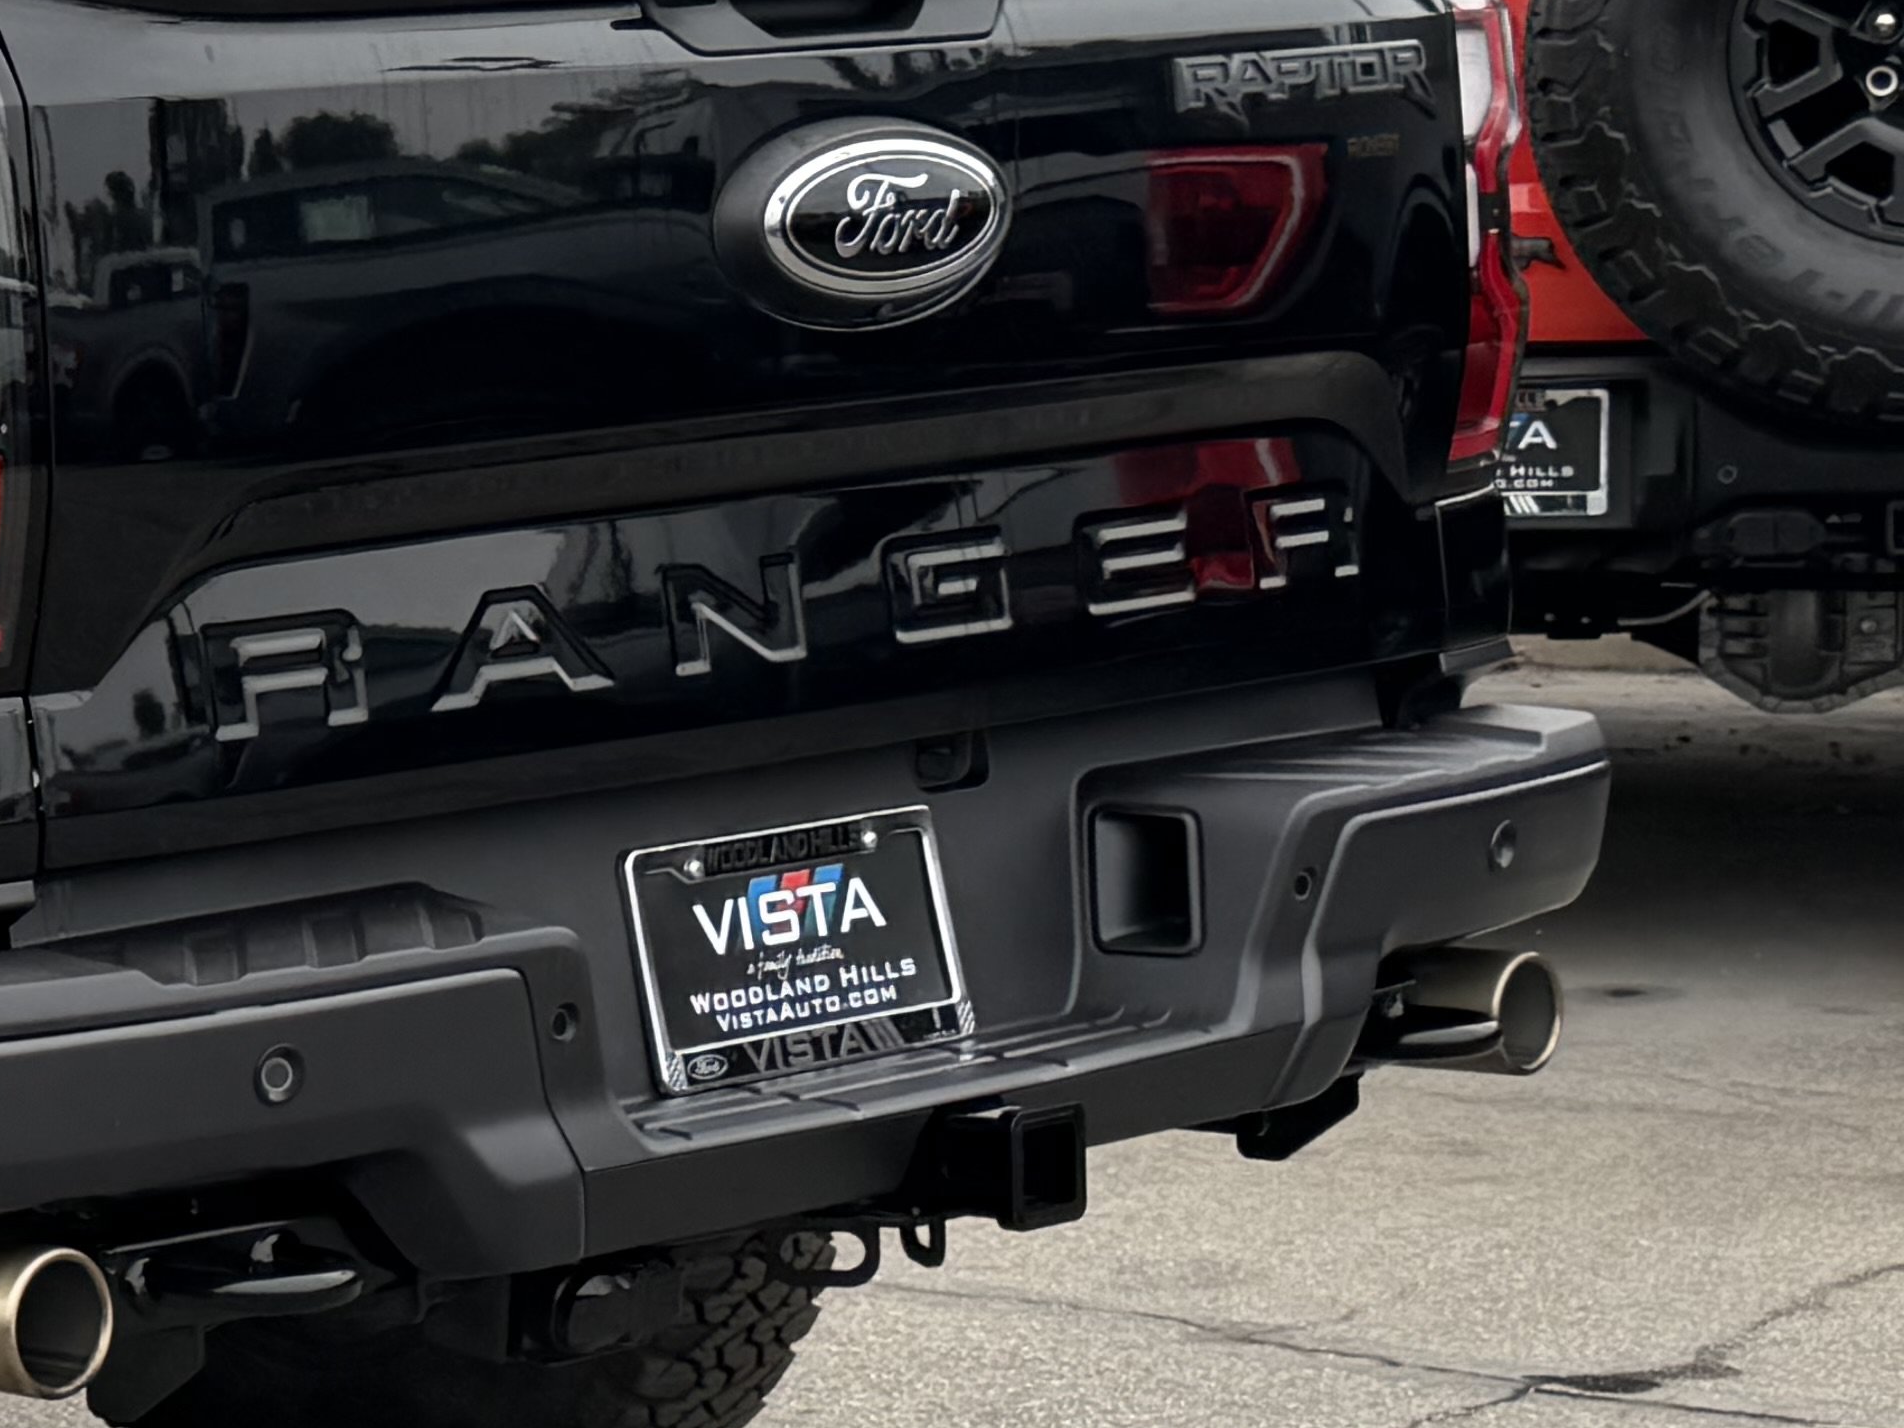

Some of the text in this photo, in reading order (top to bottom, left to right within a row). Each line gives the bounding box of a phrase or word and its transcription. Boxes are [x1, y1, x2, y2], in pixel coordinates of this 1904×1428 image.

[1172, 38, 1436, 134] RAPTOR
[834, 172, 961, 259] Ford
[197, 484, 1360, 742] RANGER
[692, 876, 887, 956] VISTA
[689, 957, 918, 1016] WOODLAND HILLS
[742, 1021, 875, 1073] VISTA
